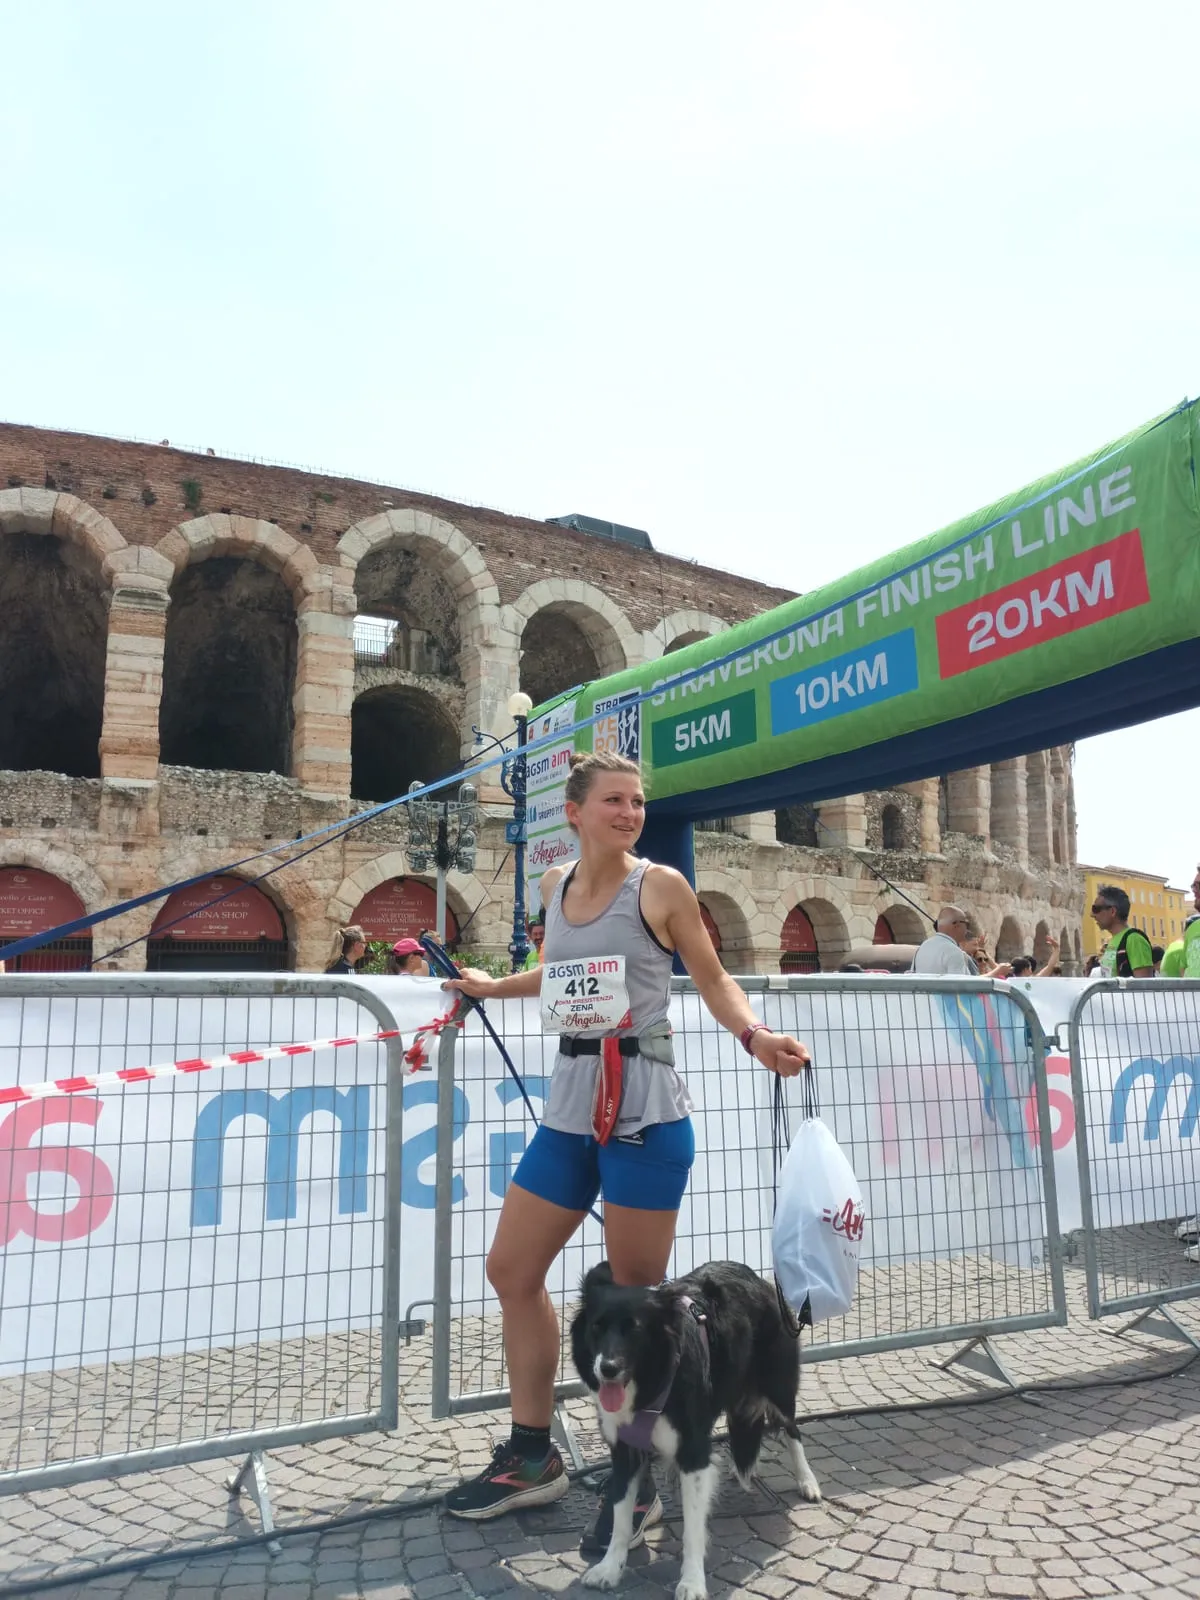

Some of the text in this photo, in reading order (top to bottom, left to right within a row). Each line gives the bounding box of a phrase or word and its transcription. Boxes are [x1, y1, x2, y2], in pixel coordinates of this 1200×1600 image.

[651, 466, 1137, 706] STRAVERONA FINISH LINE
[967, 559, 1114, 653] 20KM
[795, 651, 890, 714] 10KM
[595, 697, 618, 714] STRA
[675, 709, 731, 752] 5KM
[565, 977, 600, 997] 412
[570, 1003, 594, 1012] ZENA
